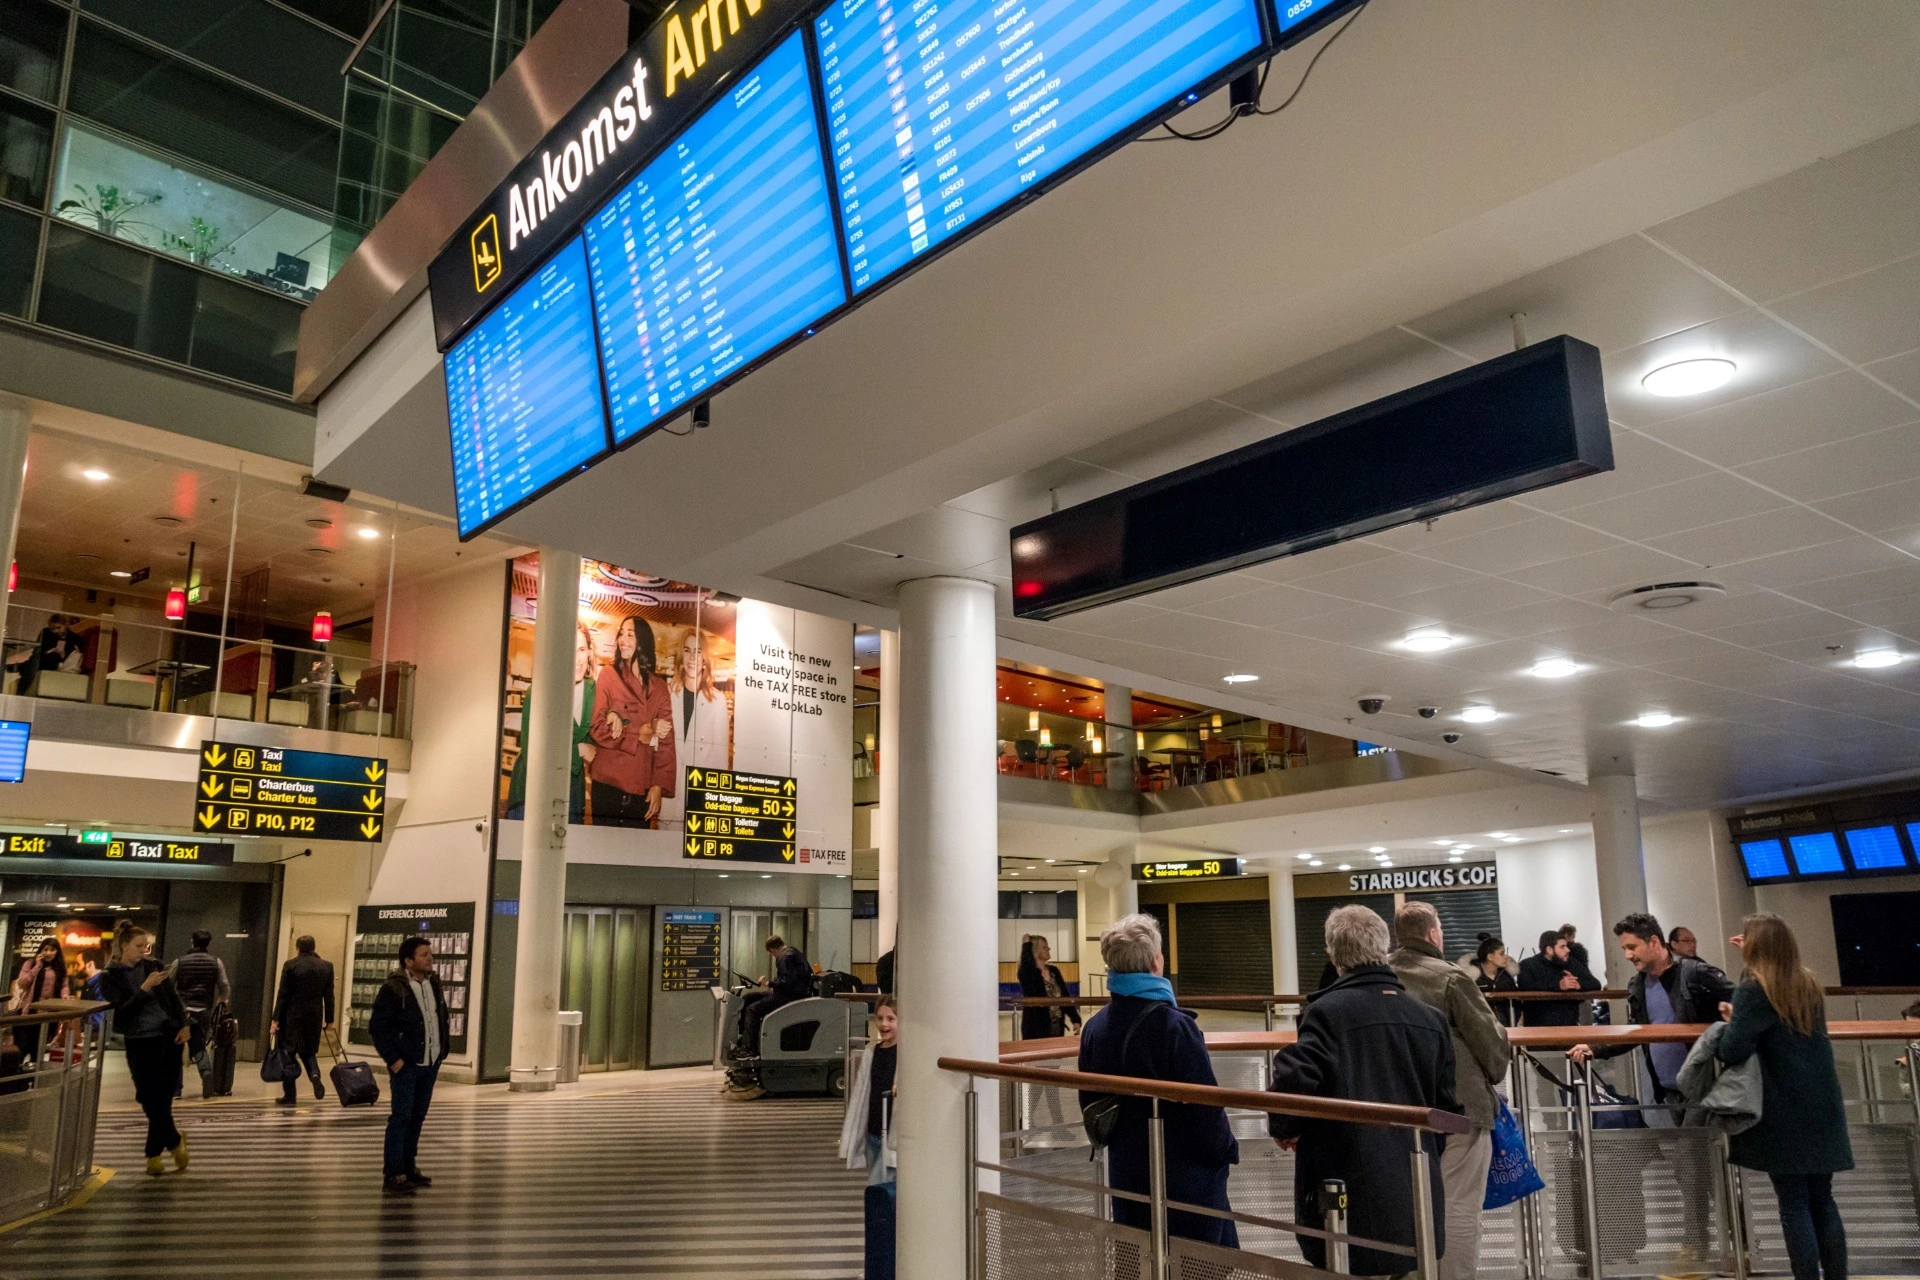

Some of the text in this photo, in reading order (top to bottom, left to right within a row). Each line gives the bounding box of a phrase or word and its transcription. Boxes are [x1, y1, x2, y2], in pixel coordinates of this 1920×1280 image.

[509, 57, 652, 251] Ankomst
[760, 643, 832, 668] Visit the new
[753, 659, 837, 685] beauty space in
[745, 676, 847, 705] the TAX FREE store
[772, 698, 823, 717] #LookLab
[262, 749, 283, 760] Taxi
[260, 761, 282, 773] Taxi
[258, 778, 315, 793] Charterbus
[257, 790, 317, 806] Charter bus
[705, 792, 743, 805] Stor bagage
[705, 799, 780, 816] Odd-size baggage 50
[256, 813, 286, 832] P10,
[290, 815, 316, 832] P12
[734, 818, 760, 827] Toiletter
[734, 827, 755, 836] Toilets
[9, 836, 46, 853] Exit
[129, 842, 199, 860] Taxi Taxi
[720, 843, 734, 855] P8
[811, 849, 826, 861] TAX
[827, 851, 847, 861] FREE
[1155, 863, 1188, 871] Stor bagage
[1179, 869, 1203, 877] baggage
[1203, 861, 1220, 875] 50
[1350, 868, 1455, 891] STARBUCKS
[378, 908, 448, 919] EXPERIENCE DENMARK
[1491, 1163, 1525, 1185] 1000
